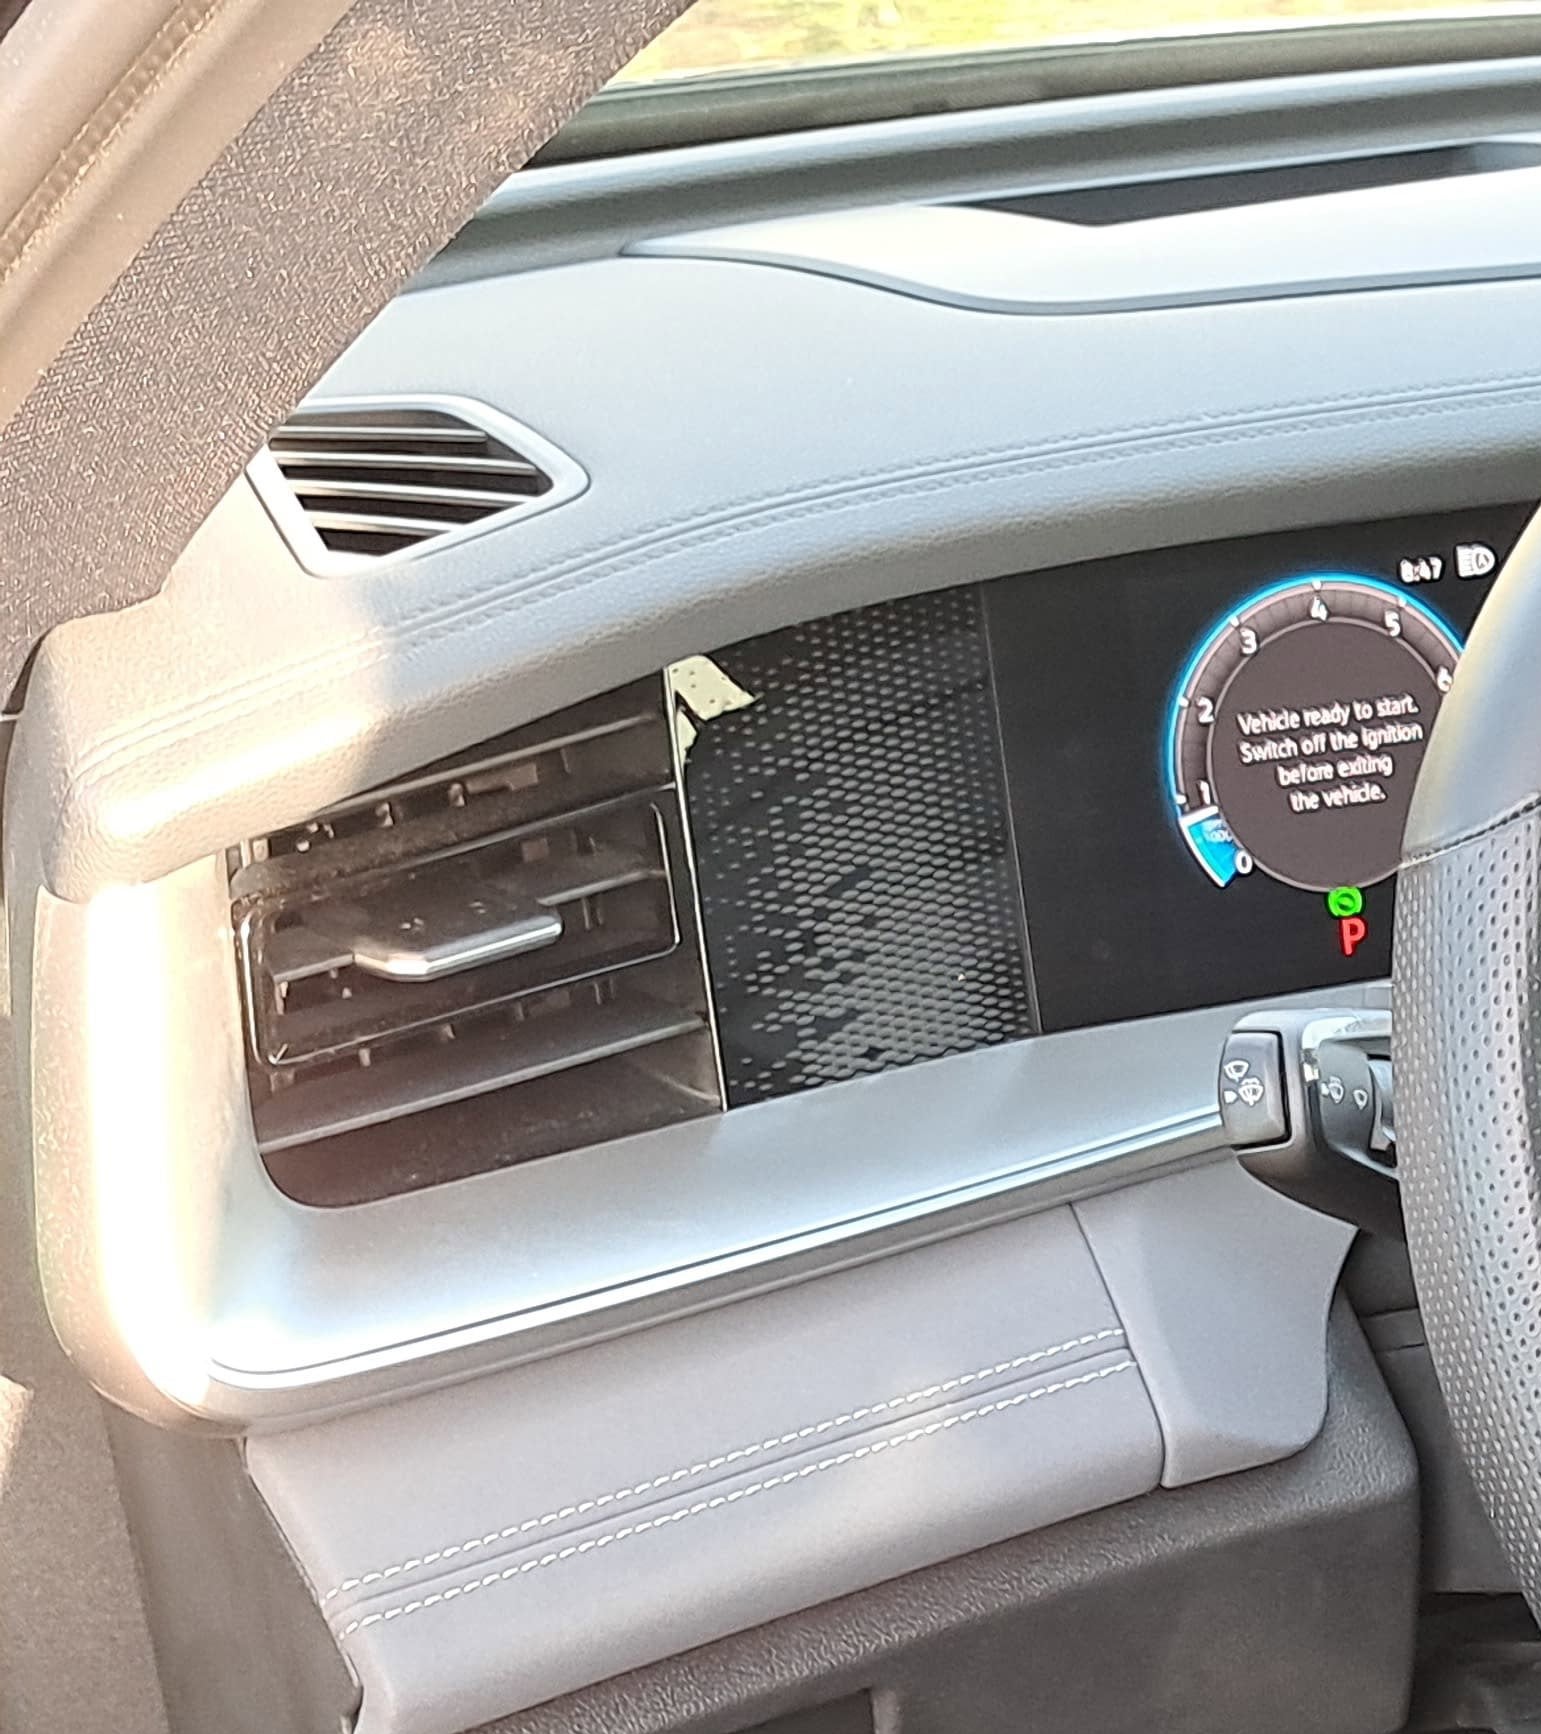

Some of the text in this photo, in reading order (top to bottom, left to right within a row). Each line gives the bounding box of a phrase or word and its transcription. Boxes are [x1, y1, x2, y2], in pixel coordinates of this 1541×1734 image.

[1310, 594, 1328, 622] 4
[1385, 608, 1401, 637] 5
[1240, 628, 1259, 656] 3
[1197, 698, 1214, 724] 2
[1237, 708, 1300, 736] Vehicle
[1302, 701, 1351, 727] ready
[1353, 699, 1373, 721] to
[1238, 736, 1298, 764] Switch
[1300, 731, 1327, 755] off
[1329, 728, 1358, 751] the
[1276, 753, 1394, 786] before exiting
[1200, 780, 1212, 806] 1
[1289, 790, 1319, 812] the
[1235, 849, 1253, 875] 0
[1340, 915, 1366, 955] P
